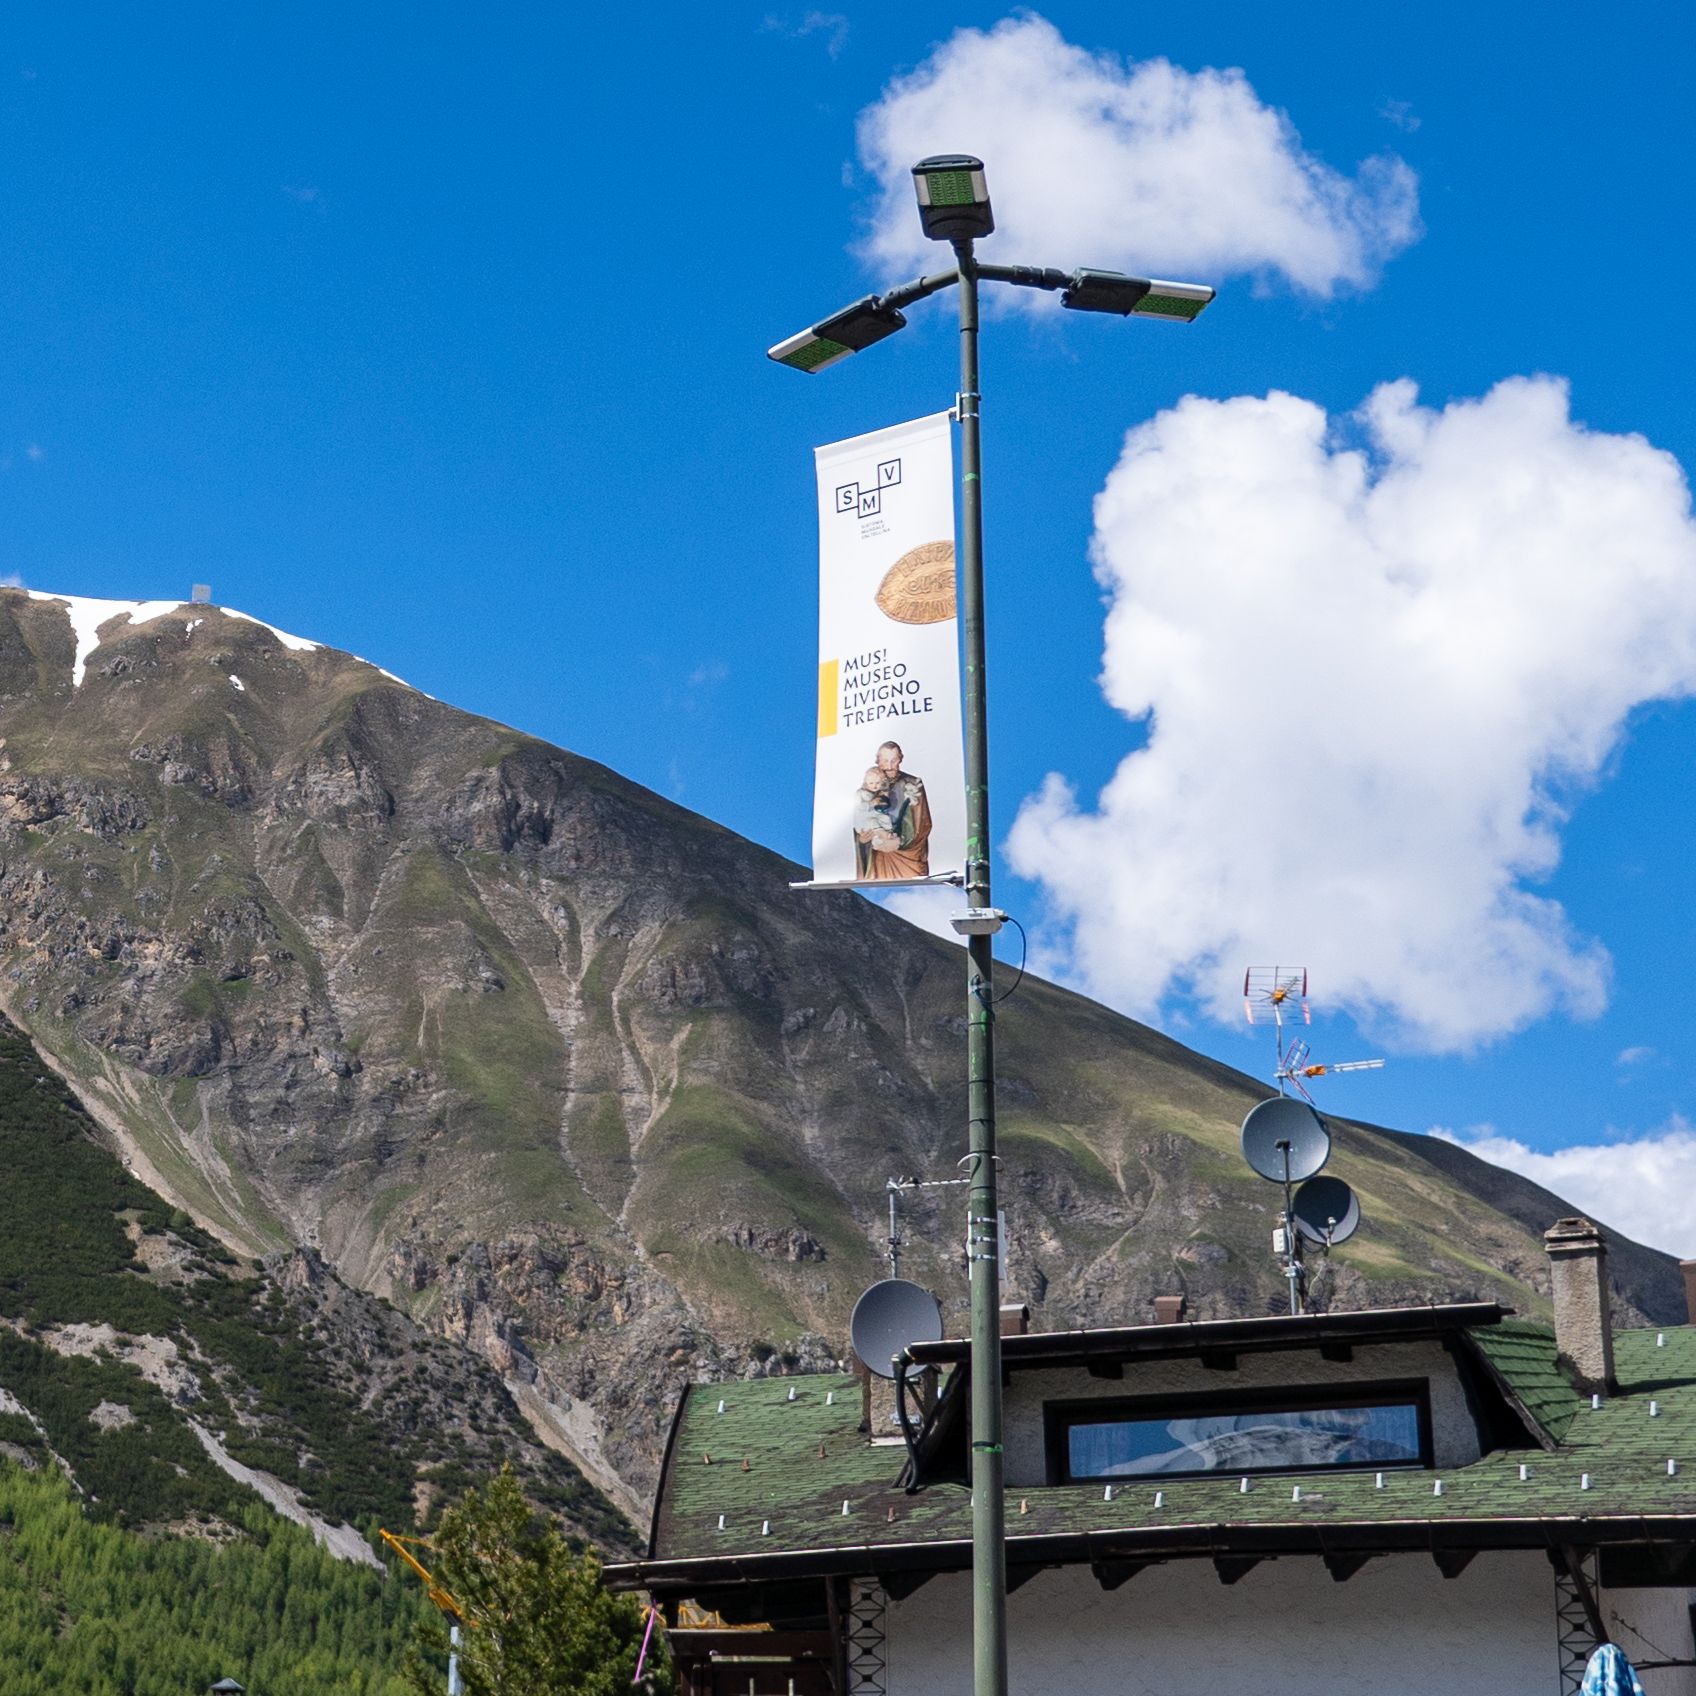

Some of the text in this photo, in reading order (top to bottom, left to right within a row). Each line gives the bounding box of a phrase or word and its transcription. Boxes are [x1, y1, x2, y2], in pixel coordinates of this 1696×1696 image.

[844, 648, 887, 673] MUS!
[844, 663, 907, 692] MUSEO
[844, 680, 920, 710] LIVIGNO
[843, 697, 934, 728] TREPALLE
